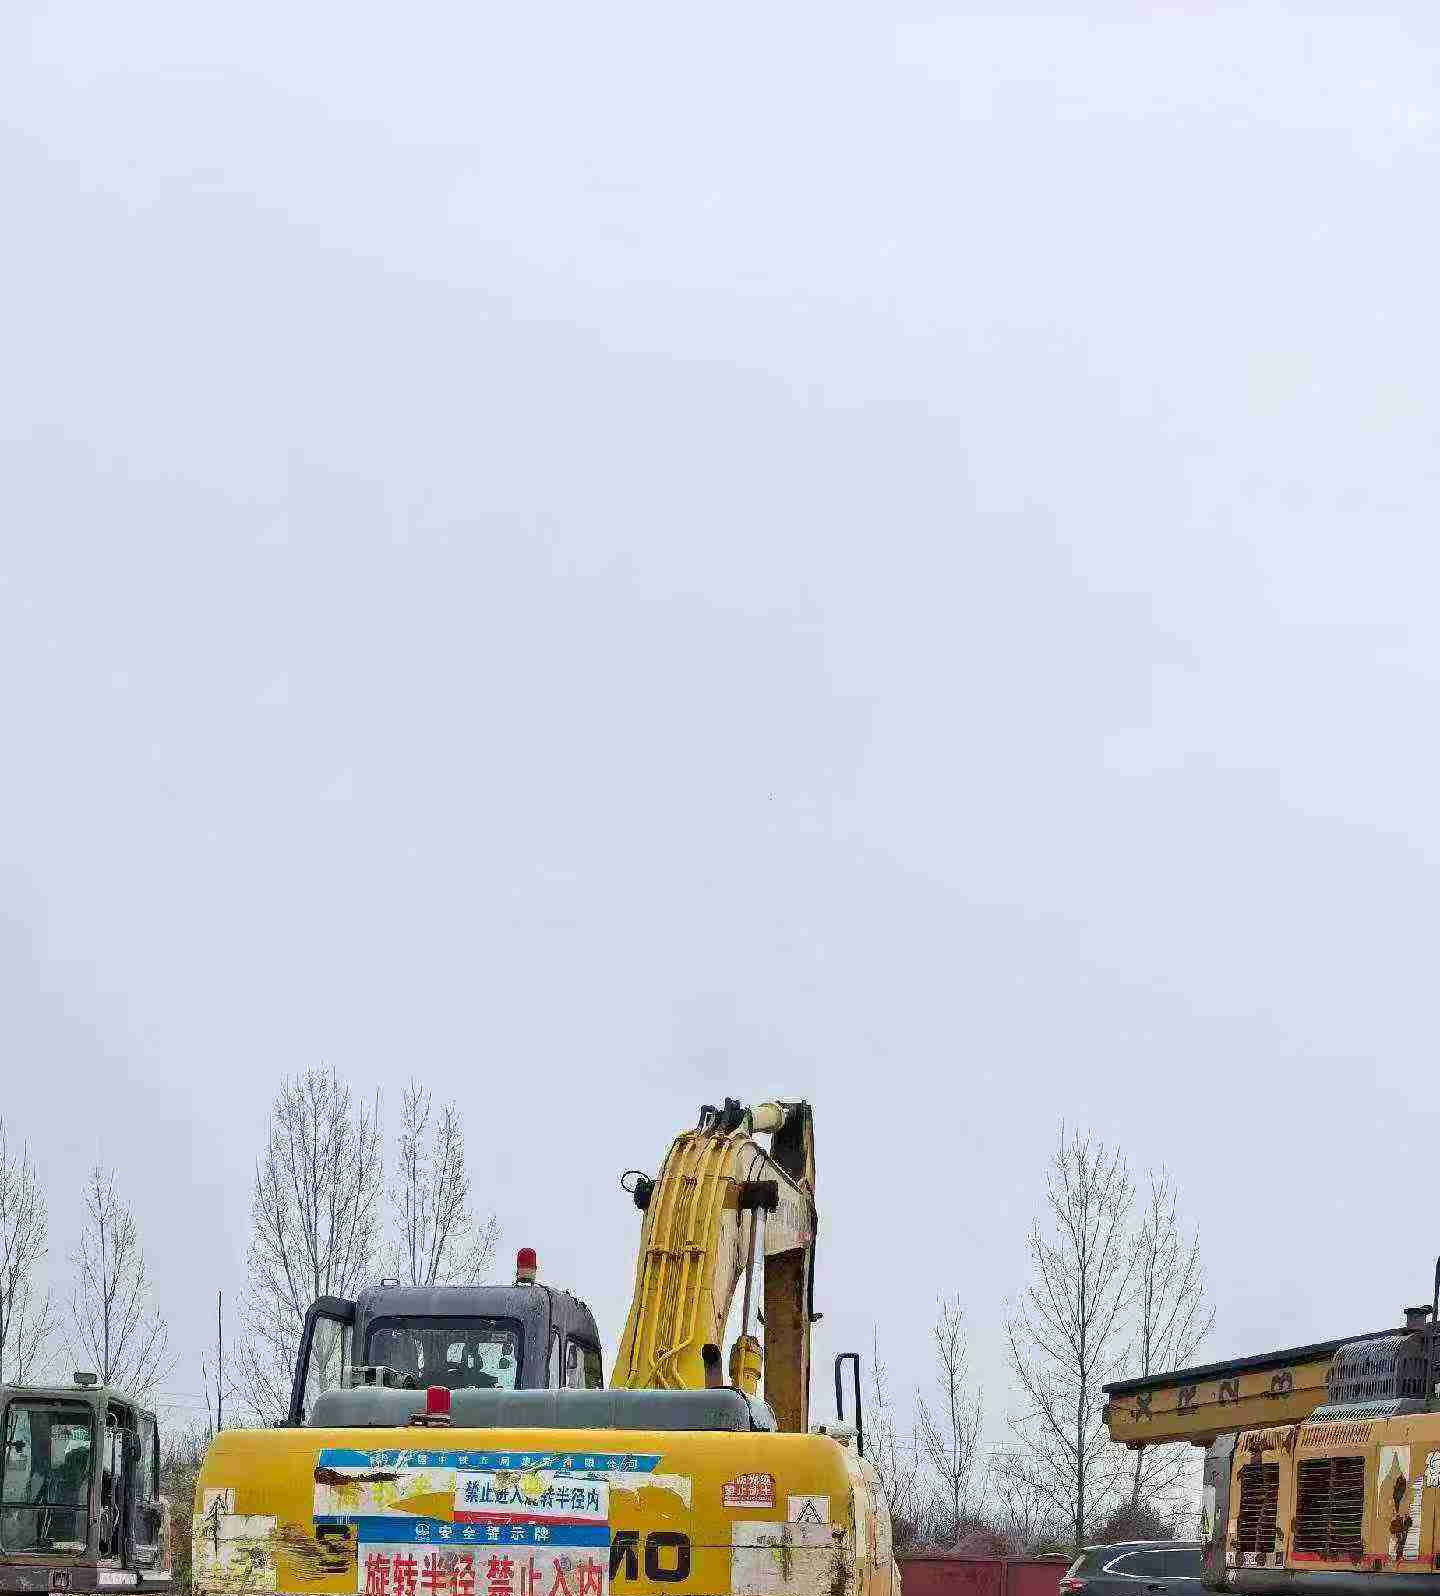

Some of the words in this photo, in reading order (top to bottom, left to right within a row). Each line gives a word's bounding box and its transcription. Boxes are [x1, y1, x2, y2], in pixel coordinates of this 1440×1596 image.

[438, 1524, 551, 1542] 安全警示牌
